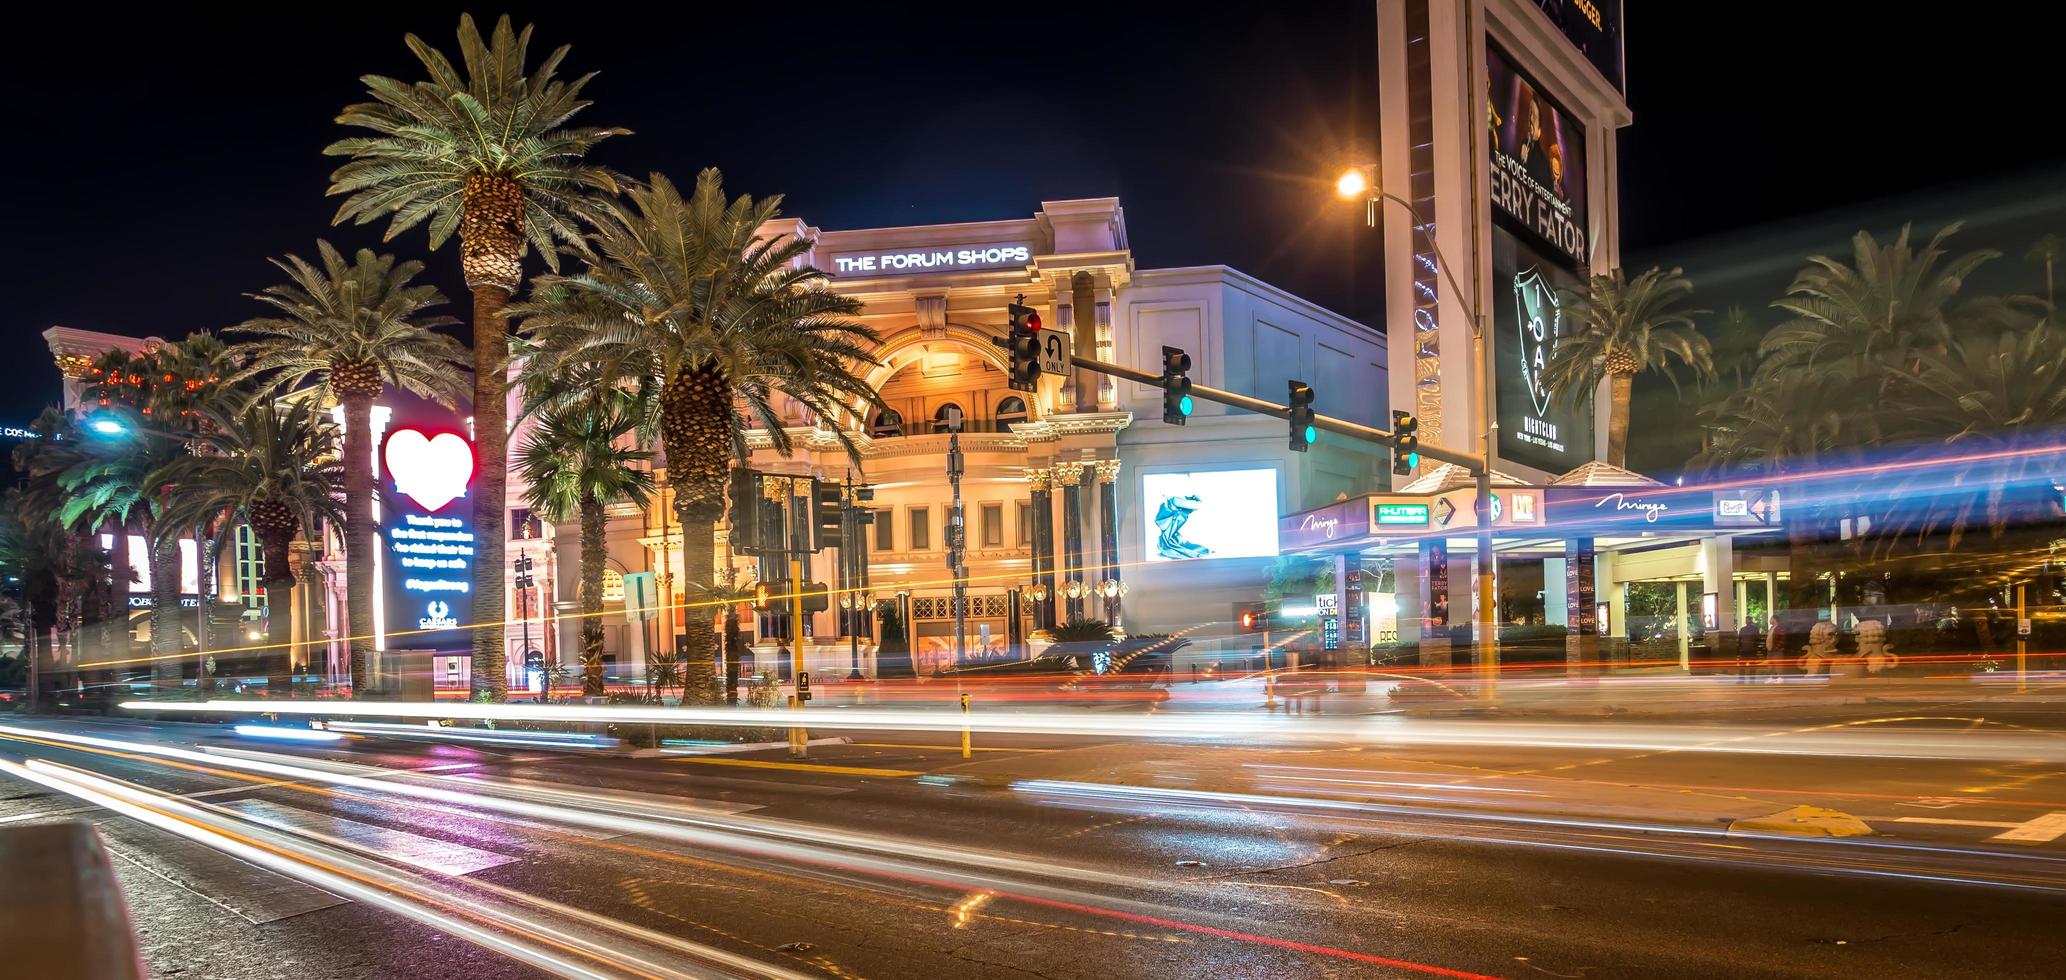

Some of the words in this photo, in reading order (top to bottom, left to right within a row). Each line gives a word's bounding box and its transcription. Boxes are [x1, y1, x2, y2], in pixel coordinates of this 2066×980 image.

[1495, 150, 1506, 169] THE
[1506, 154, 1528, 186] VOICE
[1527, 176, 1535, 188] OF
[1535, 182, 1573, 218] ENTERTAINMENT
[1490, 161, 1534, 226] ERRY
[1538, 198, 1585, 263] FATOR
[835, 256, 877, 272] THE
[881, 252, 954, 269] FORUM
[957, 246, 1029, 265] SHOPS
[1046, 361, 1064, 374] ONLY
[1524, 415, 1557, 441] NIGHTCLUB
